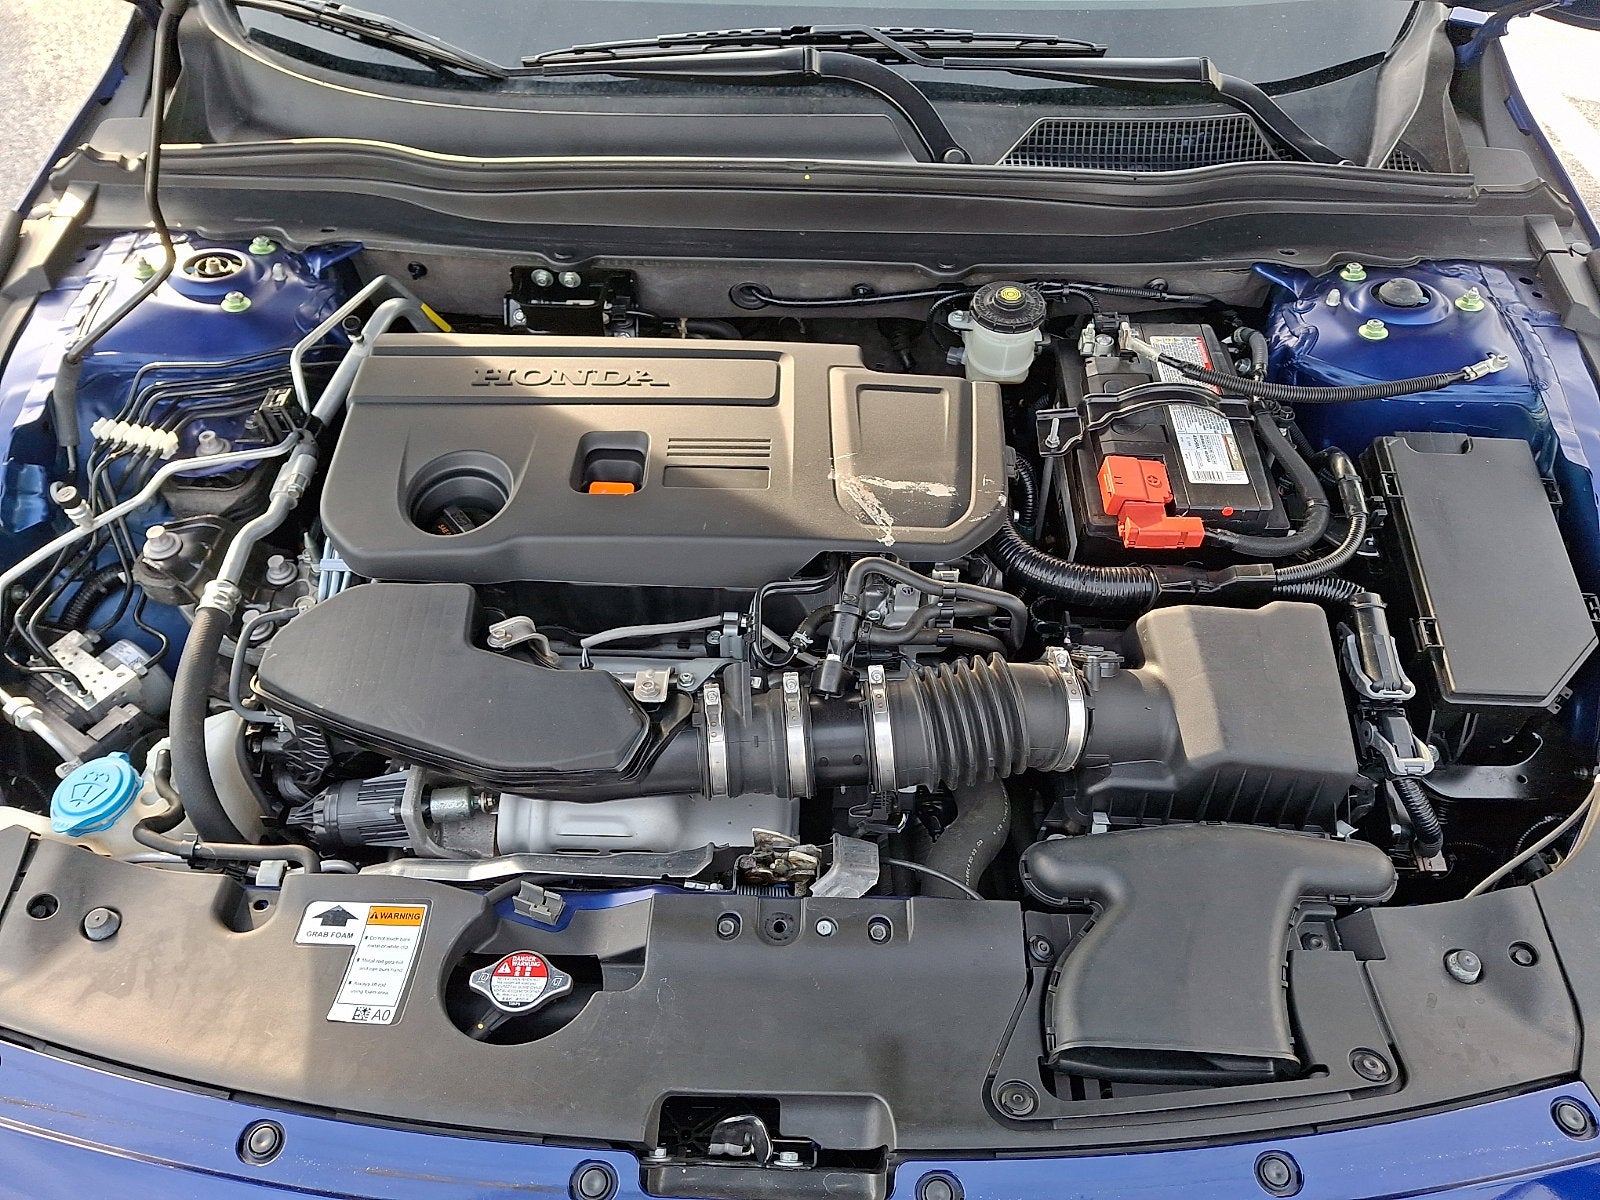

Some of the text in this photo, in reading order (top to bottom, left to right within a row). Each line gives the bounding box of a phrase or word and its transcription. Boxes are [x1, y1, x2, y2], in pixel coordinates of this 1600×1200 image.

[471, 368, 671, 387] HONDA
[380, 911, 421, 920] WARNING
[306, 930, 354, 939] GRAB FOAM
[370, 1008, 391, 1021] A0
